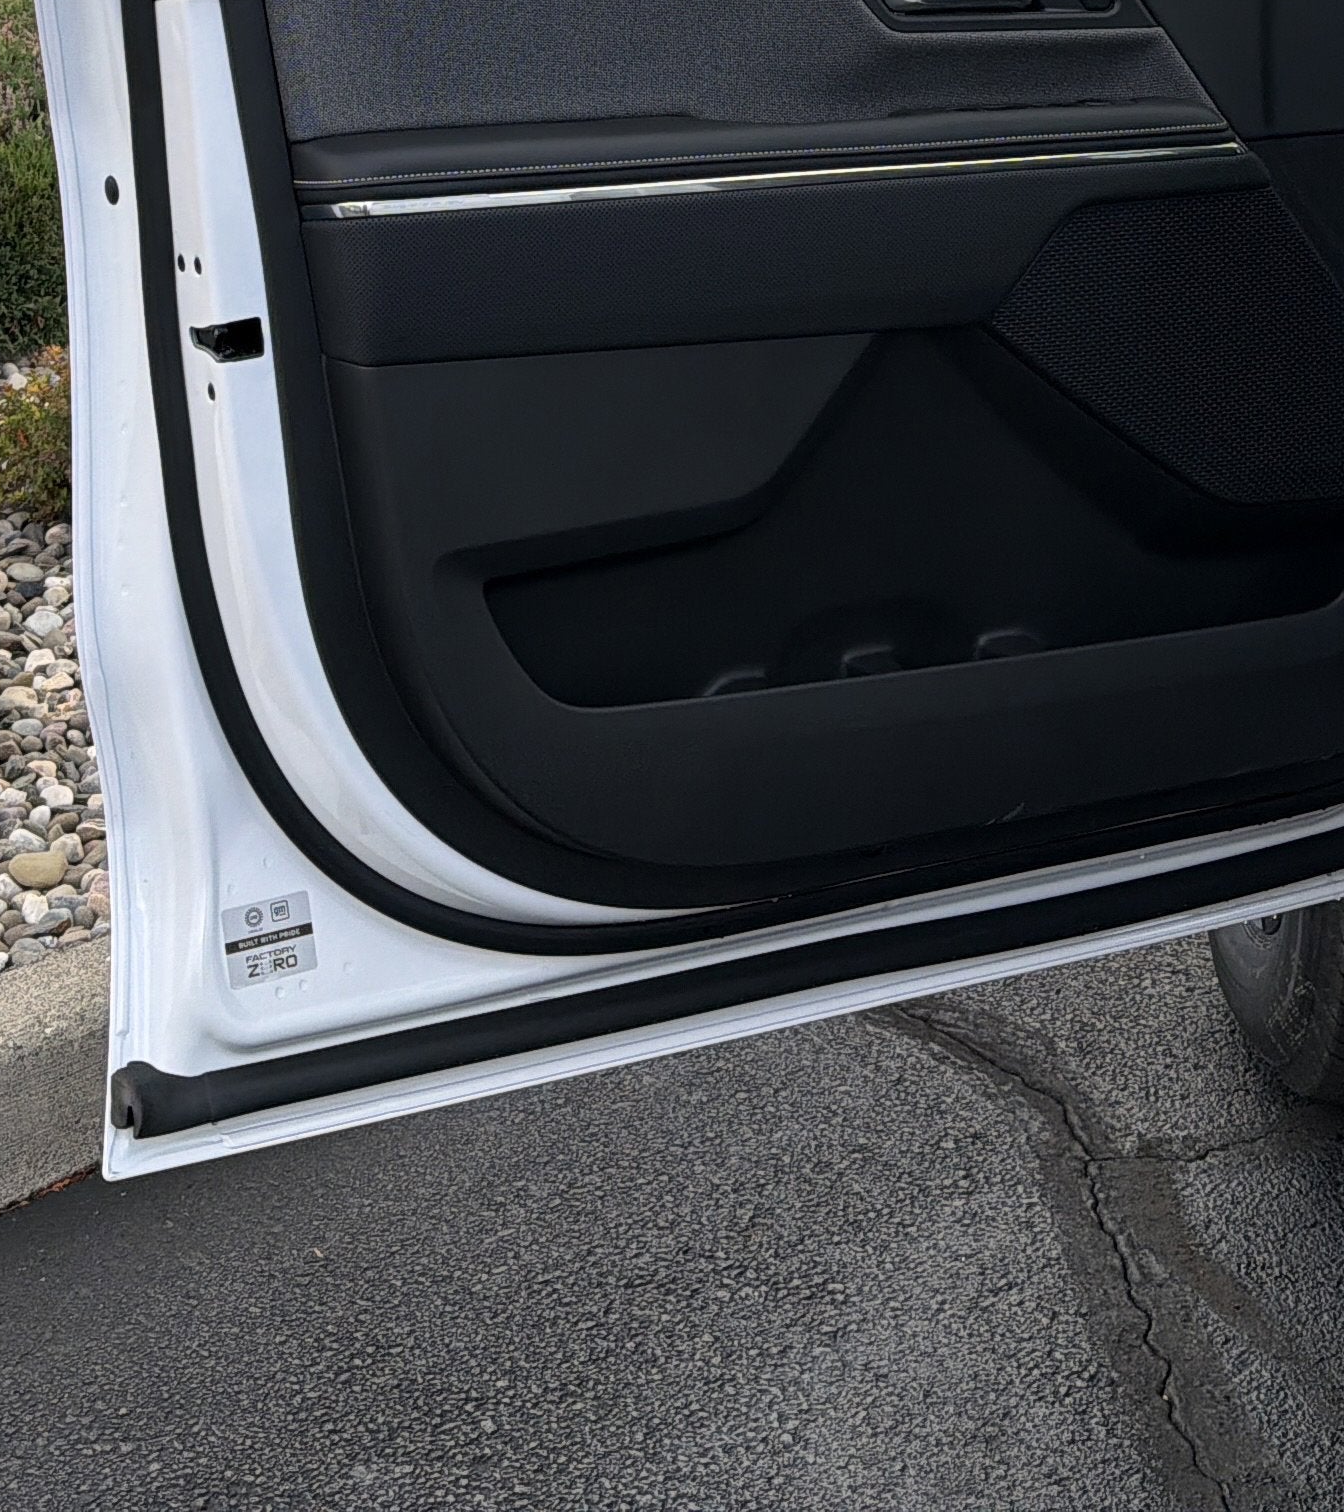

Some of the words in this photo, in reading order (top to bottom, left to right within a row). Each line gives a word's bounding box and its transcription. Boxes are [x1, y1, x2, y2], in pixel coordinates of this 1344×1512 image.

[238, 937, 259, 950] BUILT
[260, 933, 278, 944] WITH
[279, 927, 301, 940] PRIDE
[245, 944, 297, 965] FACTORY
